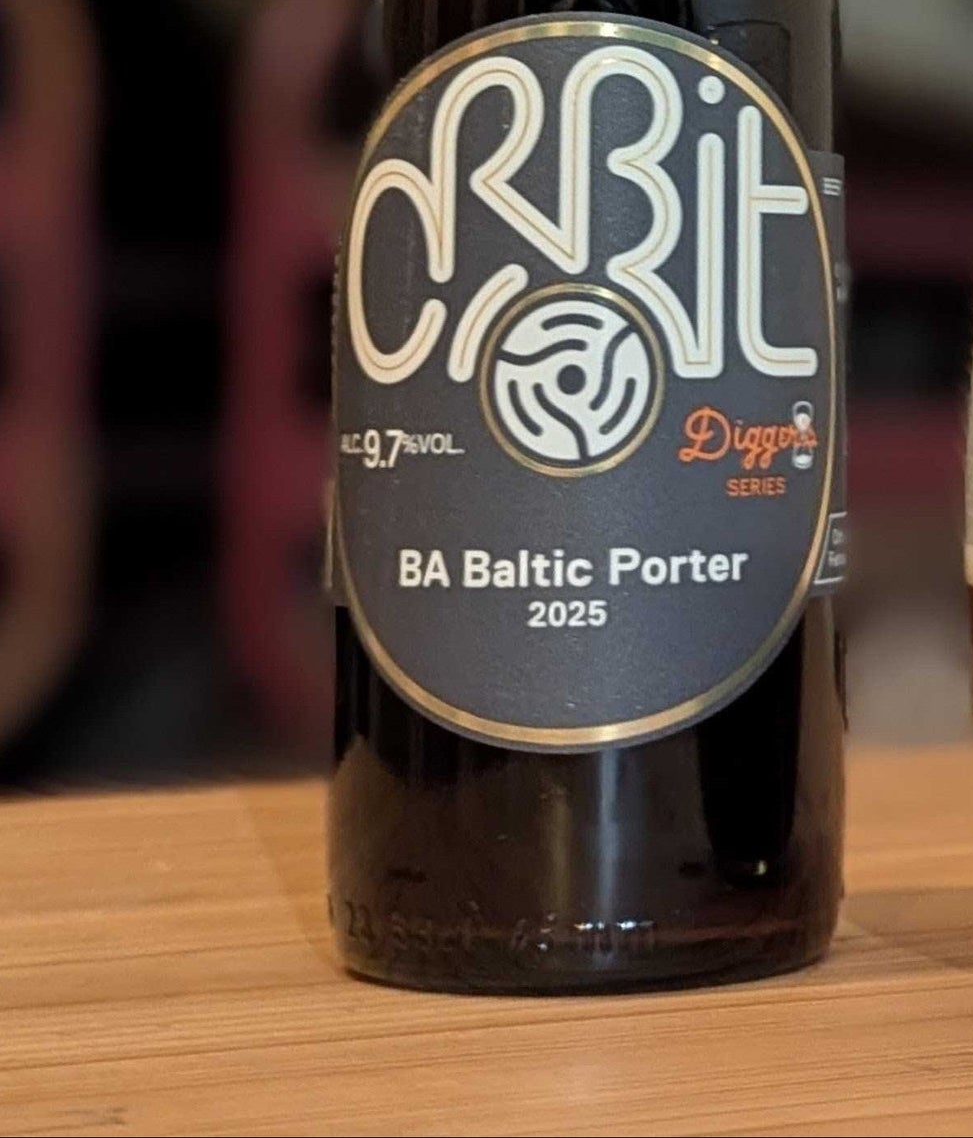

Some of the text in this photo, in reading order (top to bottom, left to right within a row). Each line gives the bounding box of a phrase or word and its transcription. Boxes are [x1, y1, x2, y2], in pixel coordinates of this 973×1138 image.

[726, 475, 787, 497] SERIES
[399, 547, 749, 588] BA Baltic Porter
[527, 600, 608, 628] 2025
